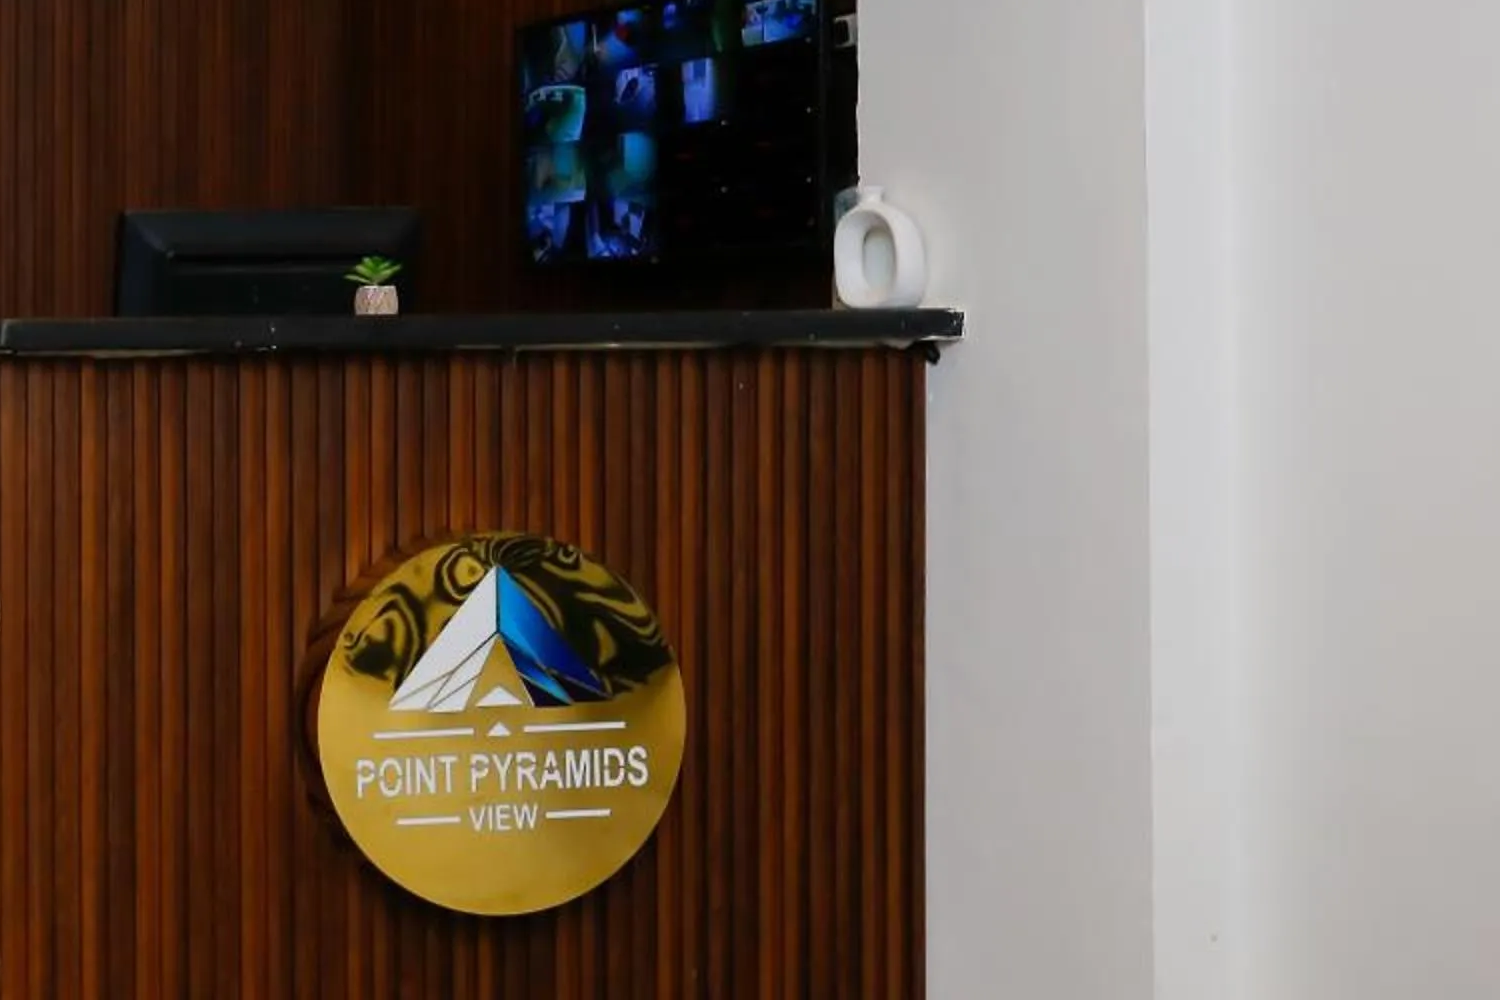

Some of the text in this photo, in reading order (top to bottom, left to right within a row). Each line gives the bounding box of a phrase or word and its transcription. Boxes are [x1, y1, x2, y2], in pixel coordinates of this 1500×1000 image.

[356, 746, 649, 798] POINT PYRAMIDS
[469, 803, 538, 831] VIEW
